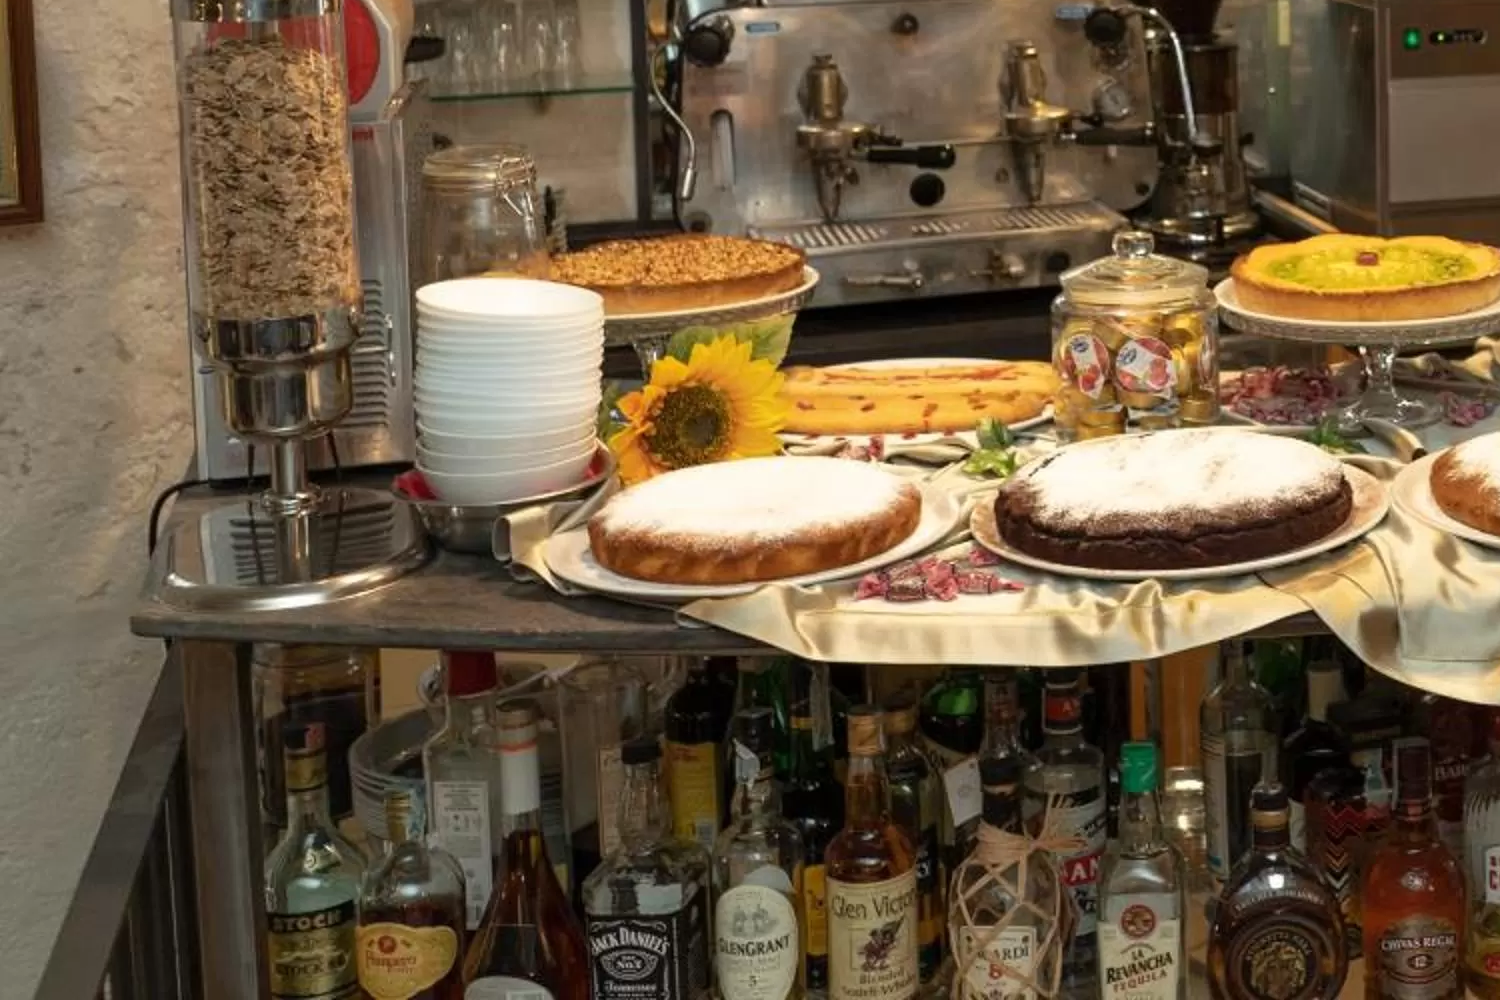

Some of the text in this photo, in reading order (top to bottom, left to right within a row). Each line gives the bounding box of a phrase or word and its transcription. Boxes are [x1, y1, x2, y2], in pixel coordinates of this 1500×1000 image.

[589, 926, 671, 957] JACK DANIEL'S
[1106, 951, 1173, 985] REVANCHA
